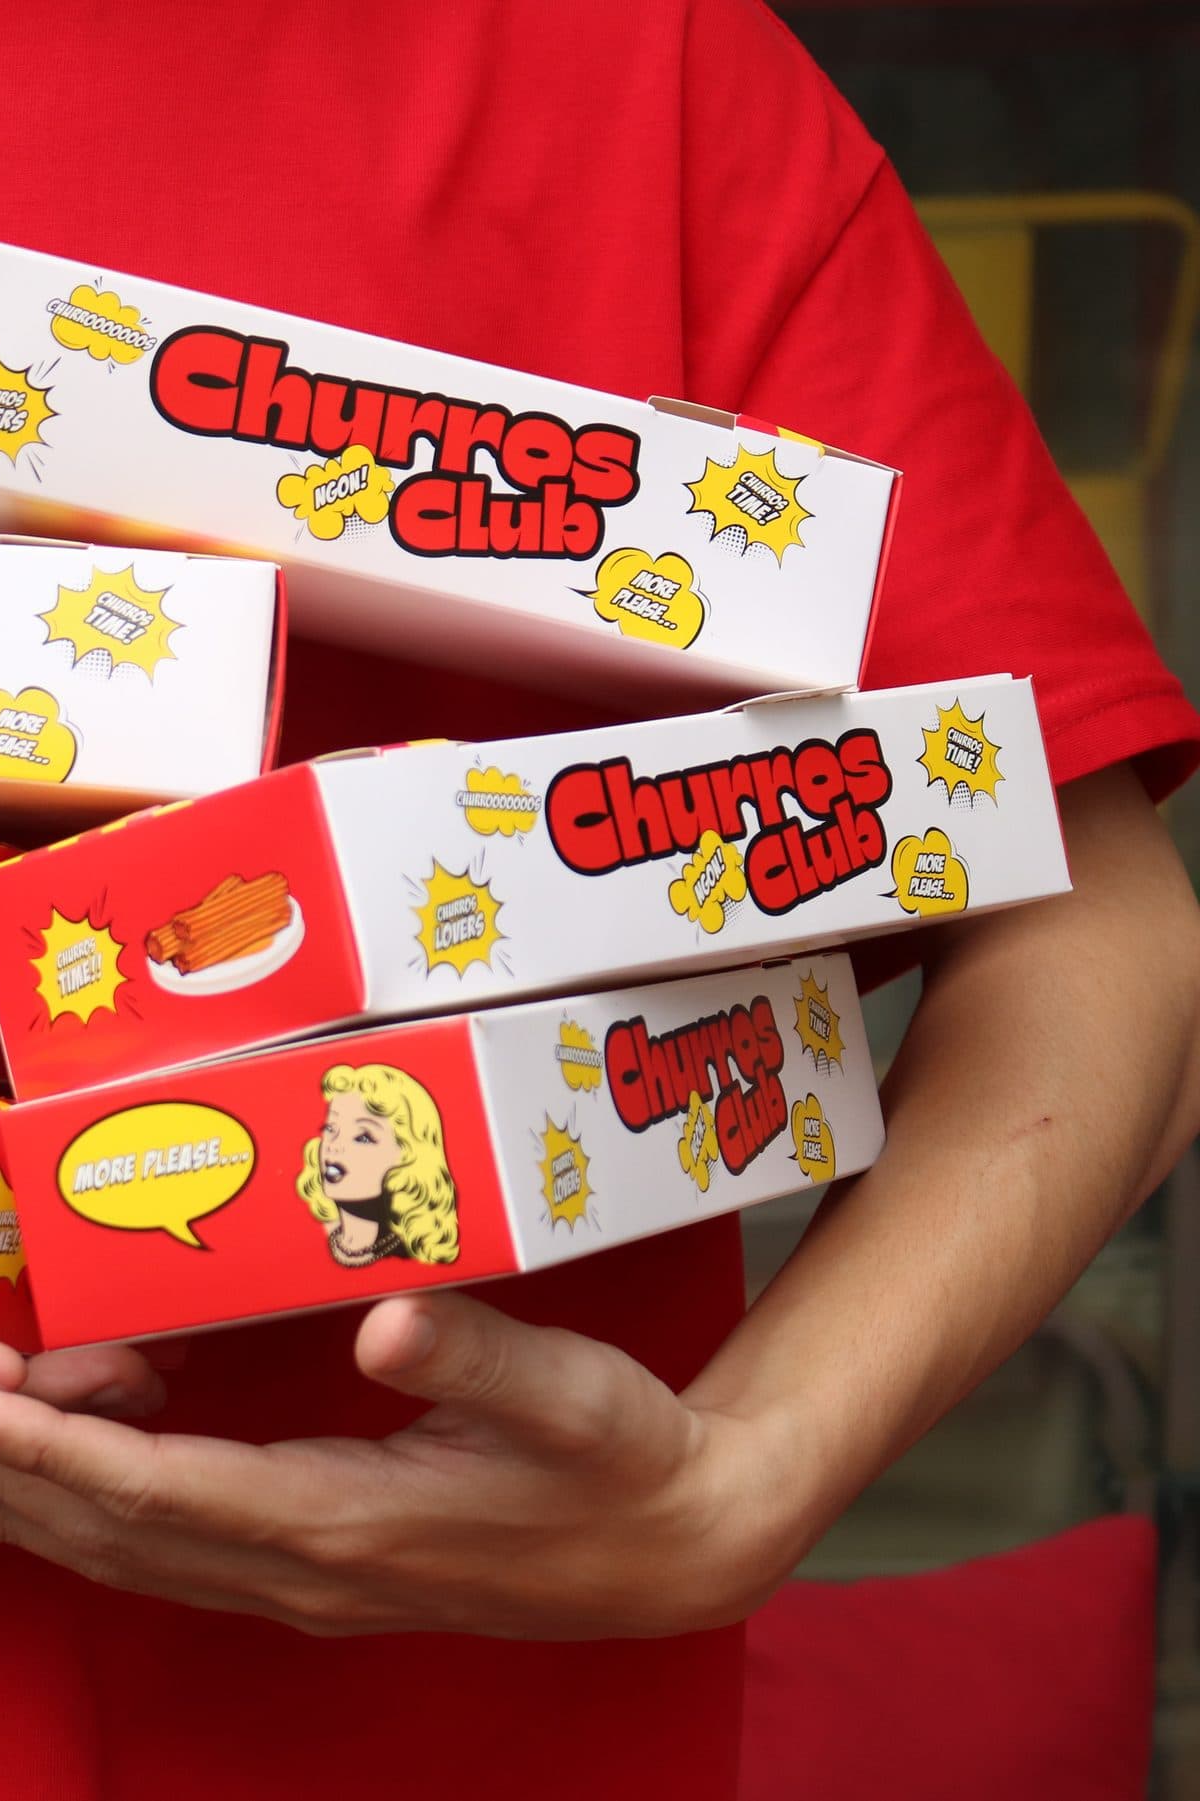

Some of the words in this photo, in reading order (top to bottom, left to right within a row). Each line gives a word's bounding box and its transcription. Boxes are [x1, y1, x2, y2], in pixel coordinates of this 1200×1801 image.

[150, 324, 640, 507] Churros
[313, 464, 369, 510] NGON!
[726, 484, 781, 527] TIME!
[740, 470, 788, 510] CHURROS
[388, 471, 604, 561] Club
[632, 569, 679, 600] MORE
[84, 605, 145, 645] TIME!
[96, 590, 155, 627] CHURROS
[611, 589, 677, 630] PLEASE...
[944, 740, 981, 772] TIME!
[947, 727, 983, 757] CHURROS
[546, 727, 892, 877] Churros
[695, 846, 726, 908] NGON!
[743, 799, 886, 916] Club
[913, 852, 945, 876] MORE
[908, 876, 955, 901] PLEASE...
[436, 895, 477, 924] CHURROS
[56, 936, 96, 971] CHURROS
[434, 917, 485, 950] LOVERS
[57, 956, 103, 999] TIME!!
[605, 995, 784, 1133] Churros
[715, 1064, 787, 1176] Club
[804, 1117, 820, 1138] MORE
[72, 1152, 136, 1195] MORE
[140, 1138, 250, 1181] PLEASE...
